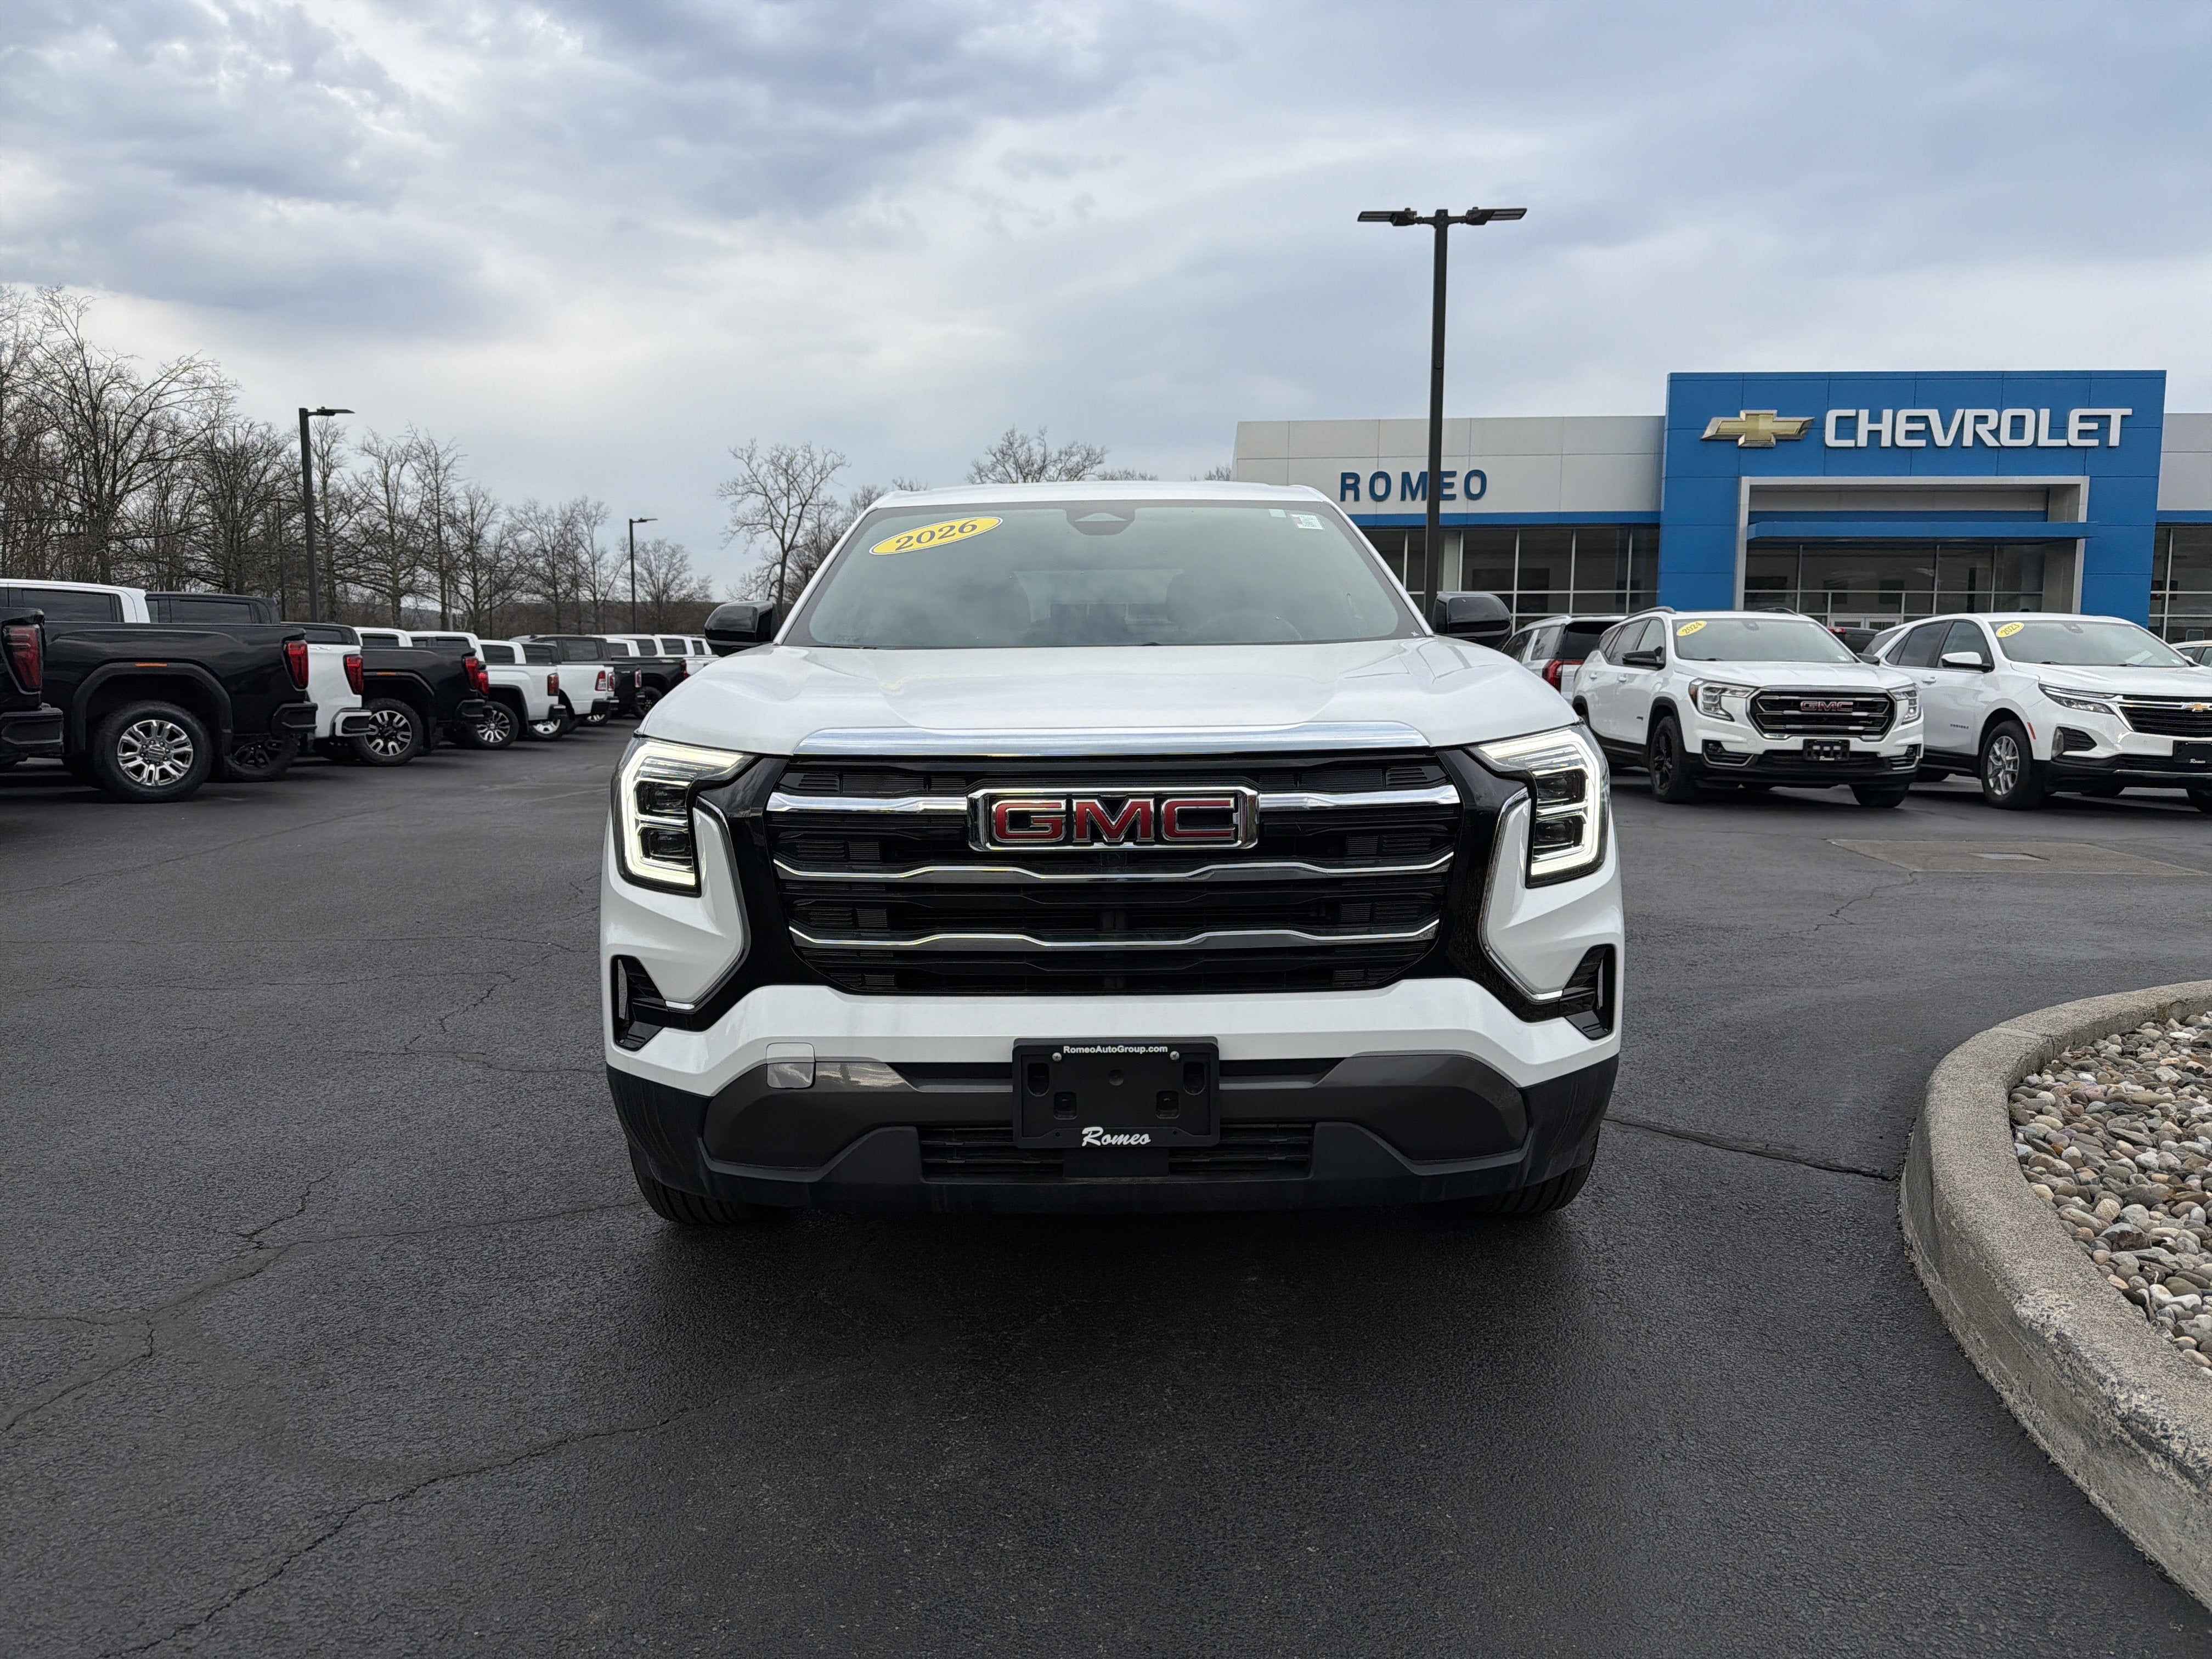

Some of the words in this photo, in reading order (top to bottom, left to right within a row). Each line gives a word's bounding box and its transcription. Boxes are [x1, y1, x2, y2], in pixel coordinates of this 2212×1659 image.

[1824, 408, 2132, 448] CHEVROLET
[1340, 469, 1487, 502] ROMEO
[894, 519, 978, 551] 2026
[2000, 623, 2020, 635] 2023
[1800, 701, 1854, 712] GMC
[991, 798, 1235, 843] GMC
[1063, 1045, 1169, 1054] RomeoAutoGroup.com
[1081, 1126, 1152, 1147] Romeo
